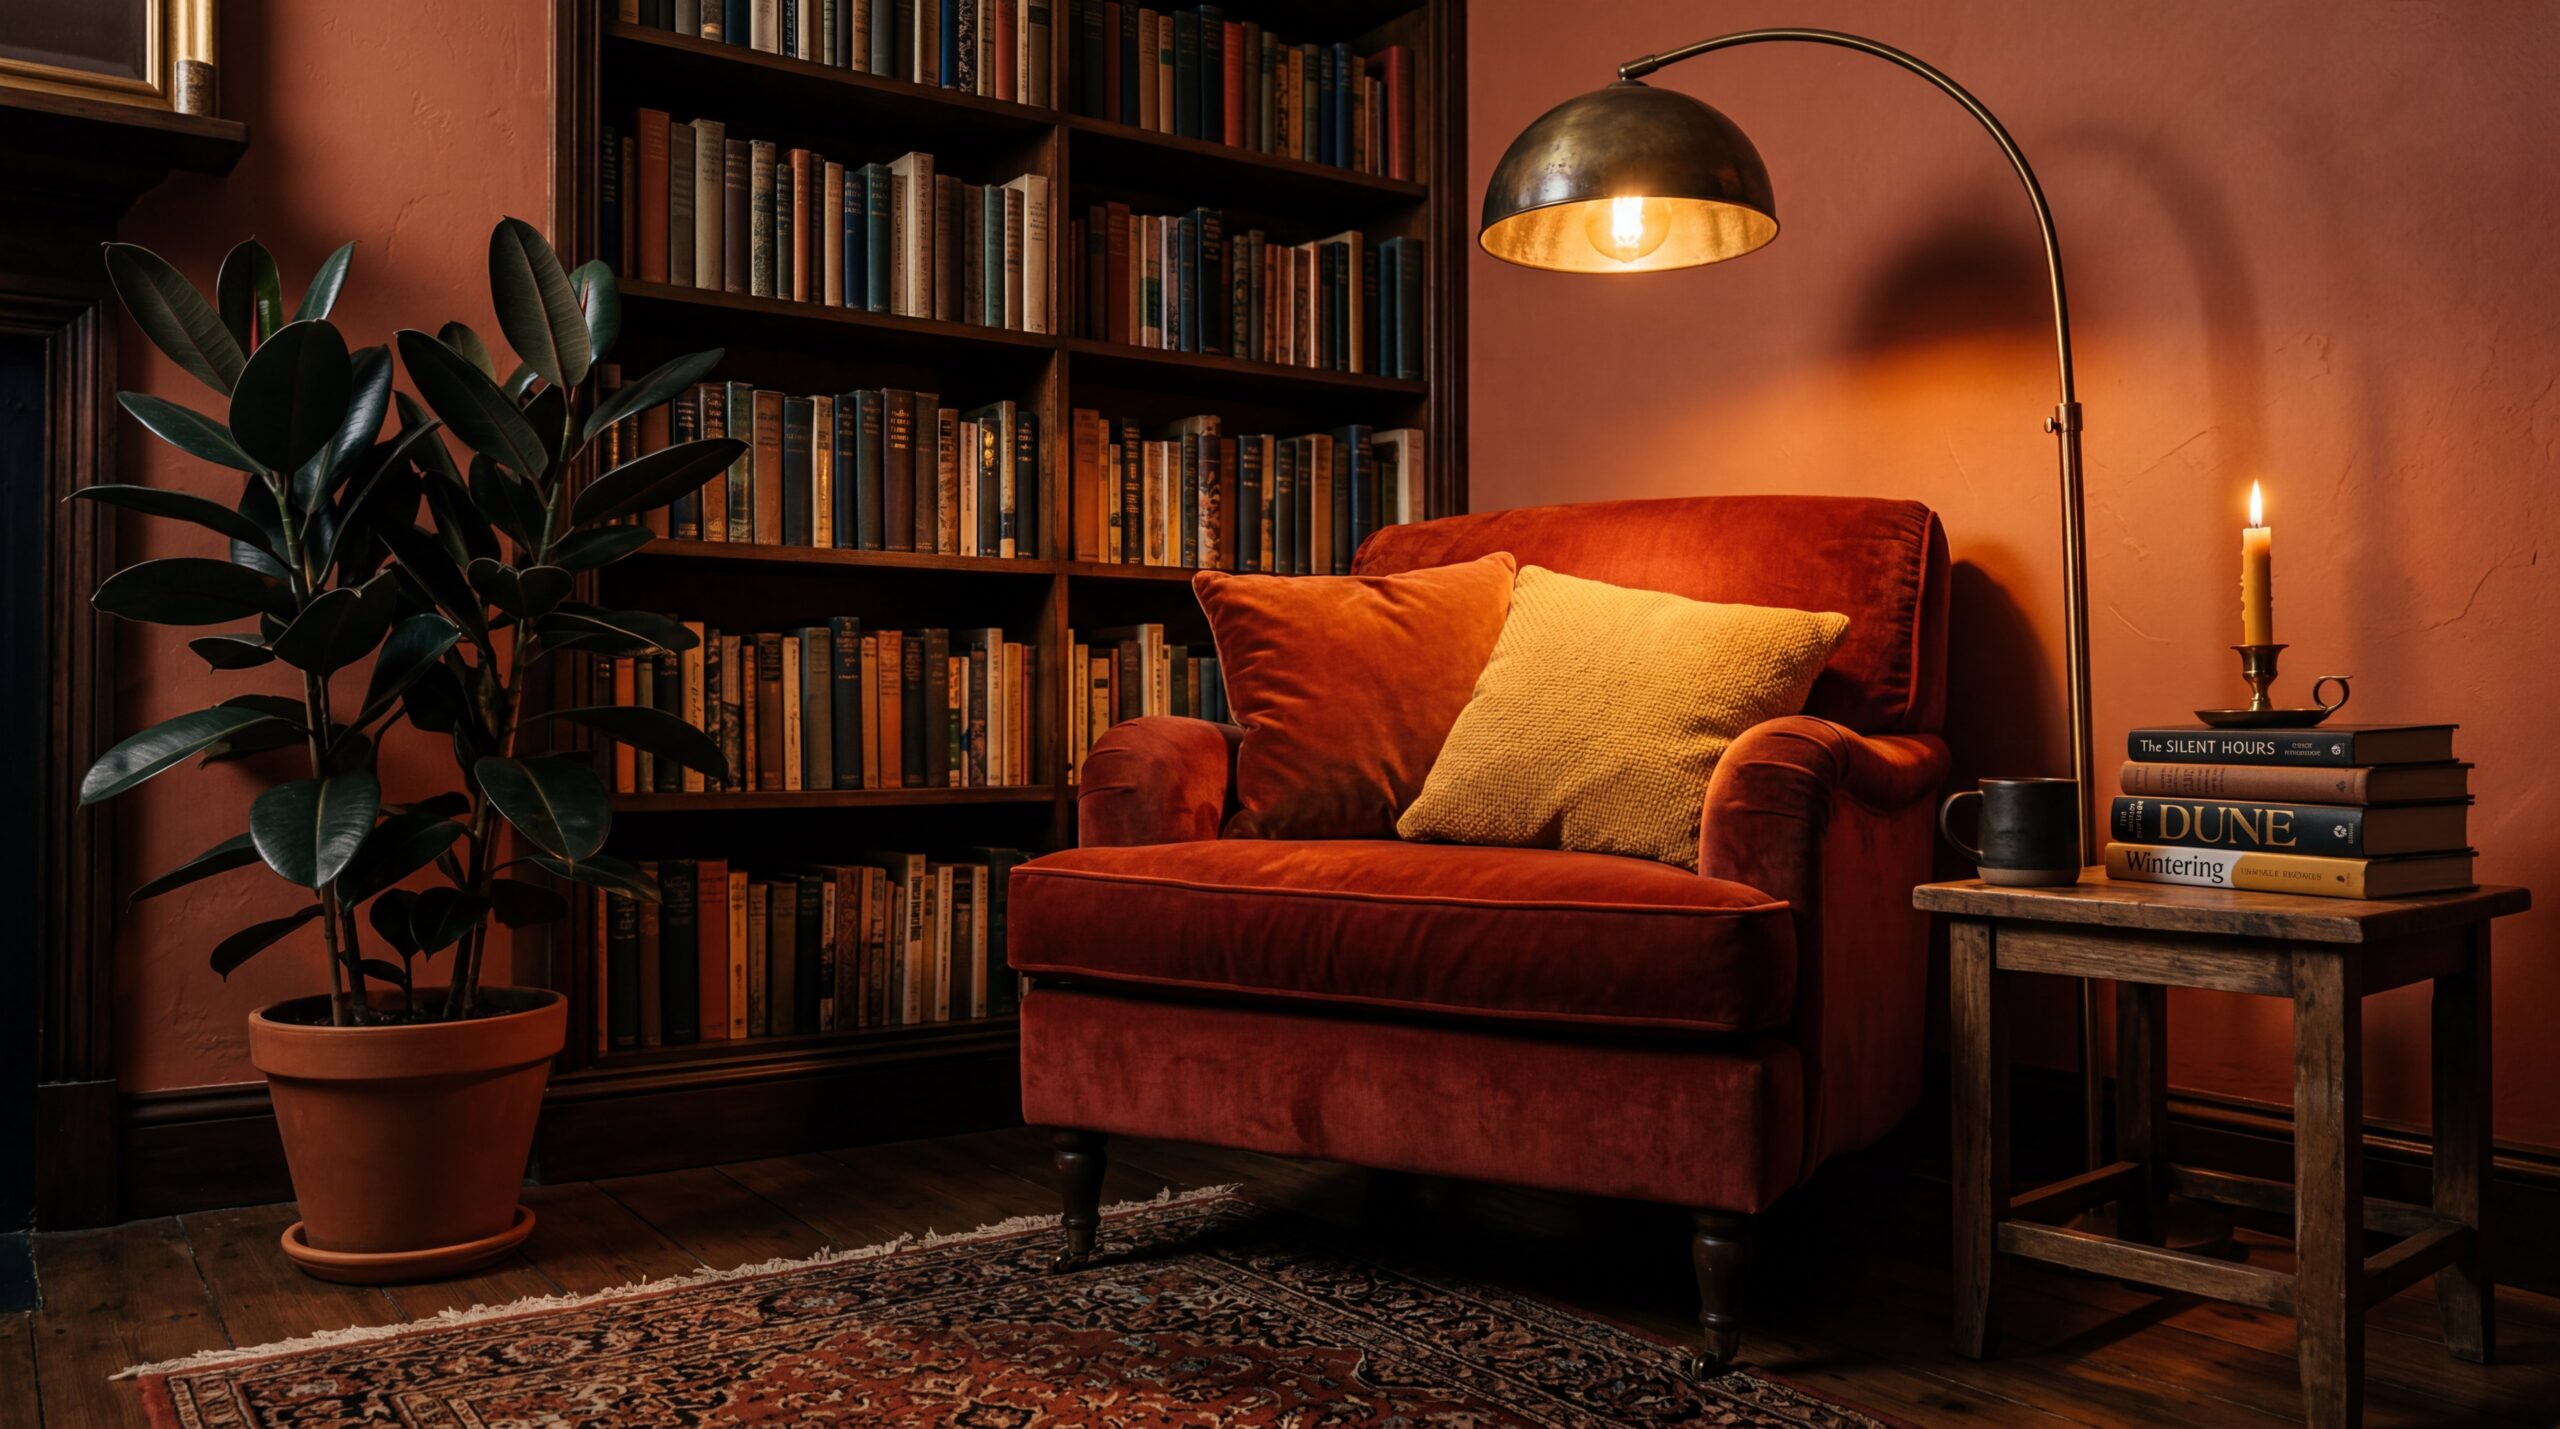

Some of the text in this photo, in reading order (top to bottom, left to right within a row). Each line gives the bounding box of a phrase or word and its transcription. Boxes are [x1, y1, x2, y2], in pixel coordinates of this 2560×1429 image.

[2140, 740, 2162, 753] The
[2166, 740, 2217, 755] SILENT
[2222, 741, 2275, 755] HOURS
[2159, 804, 2297, 847] DUNE
[2126, 850, 2224, 883] Wintering
